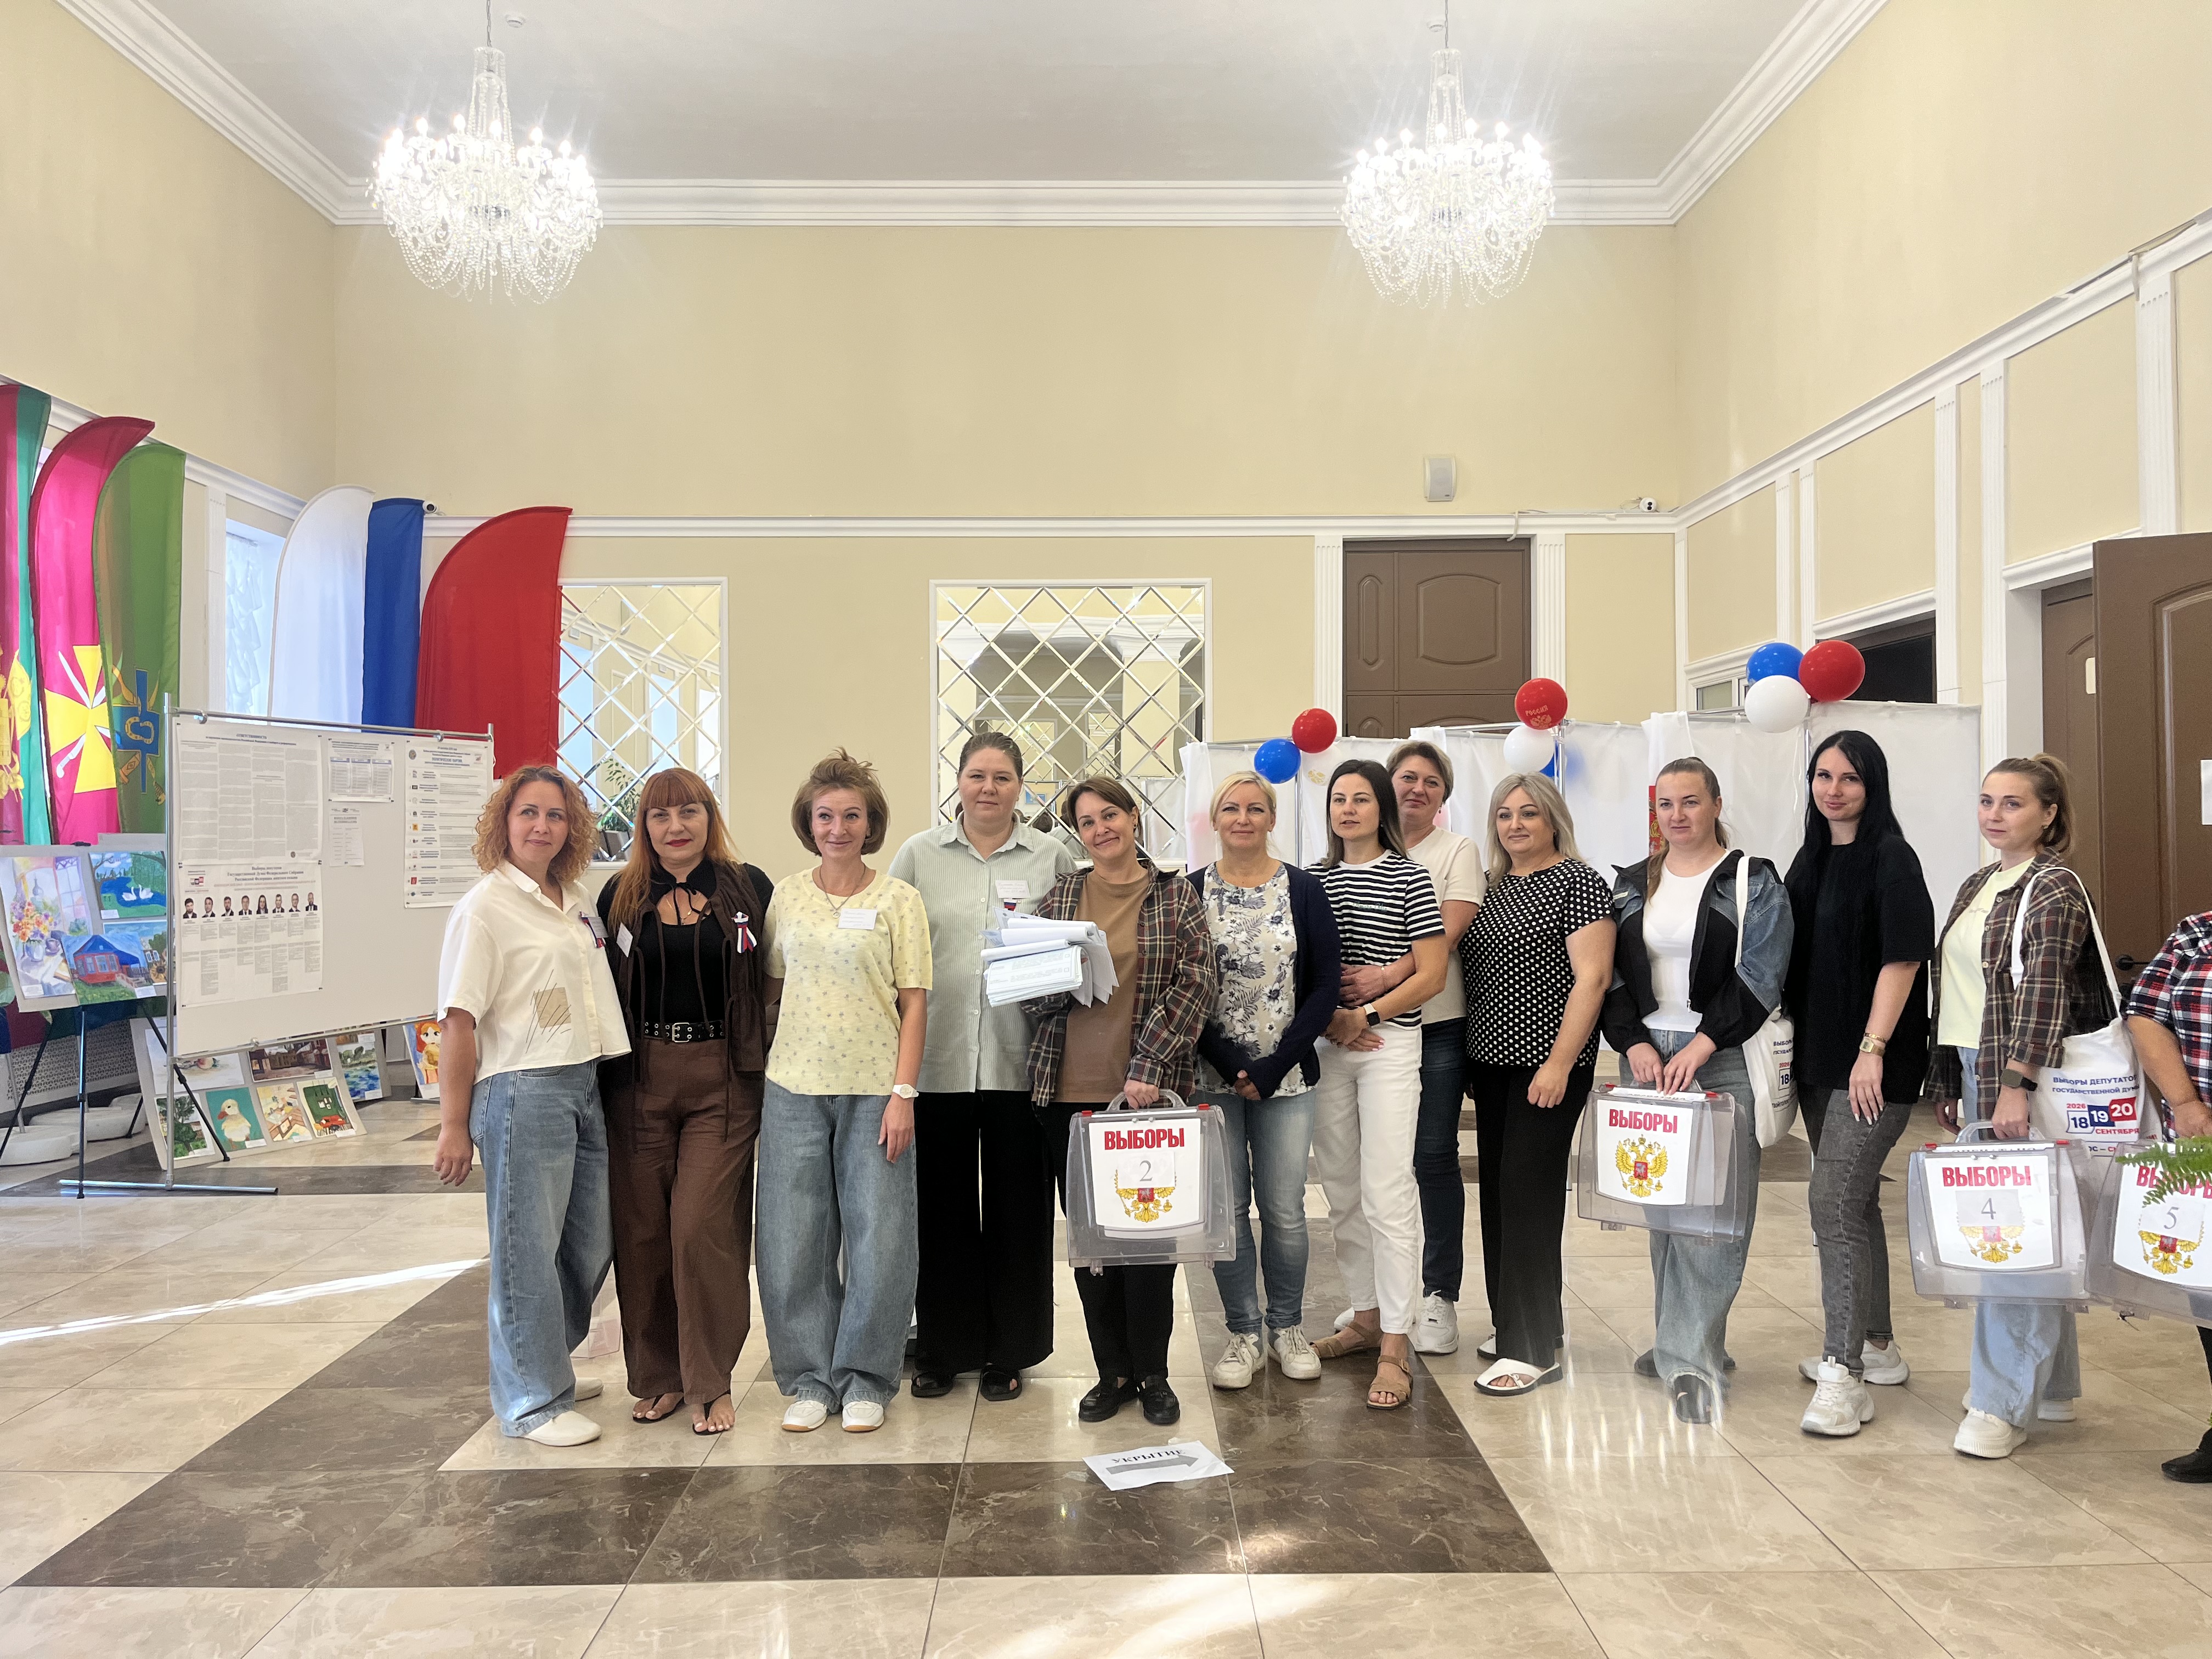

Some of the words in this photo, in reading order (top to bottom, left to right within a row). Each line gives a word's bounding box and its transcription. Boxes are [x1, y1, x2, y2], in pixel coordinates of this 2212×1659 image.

[1525, 705, 1548, 716] РОССИЯ
[1781, 1074, 1790, 1085] 18
[2053, 1077, 2087, 1085] ВЫБОРЫ
[2052, 1087, 2120, 1095] ГОСУДАРСТВЕННОЙ
[1609, 1109, 1678, 1133] ВЫБОРЫ
[2070, 1117, 2089, 1128] 18
[2090, 1110, 2109, 1122] 19
[2111, 1103, 2133, 1117] 20
[1104, 1128, 1184, 1150] ВЫБОРЫ
[1139, 1160, 1153, 1182] 2
[1942, 1166, 2032, 1187] ВЫБОРЫ
[1981, 1198, 1996, 1220] 4
[2164, 1206, 2180, 1229] 5
[1111, 1449, 1186, 1464] УКРЫТИЕ
